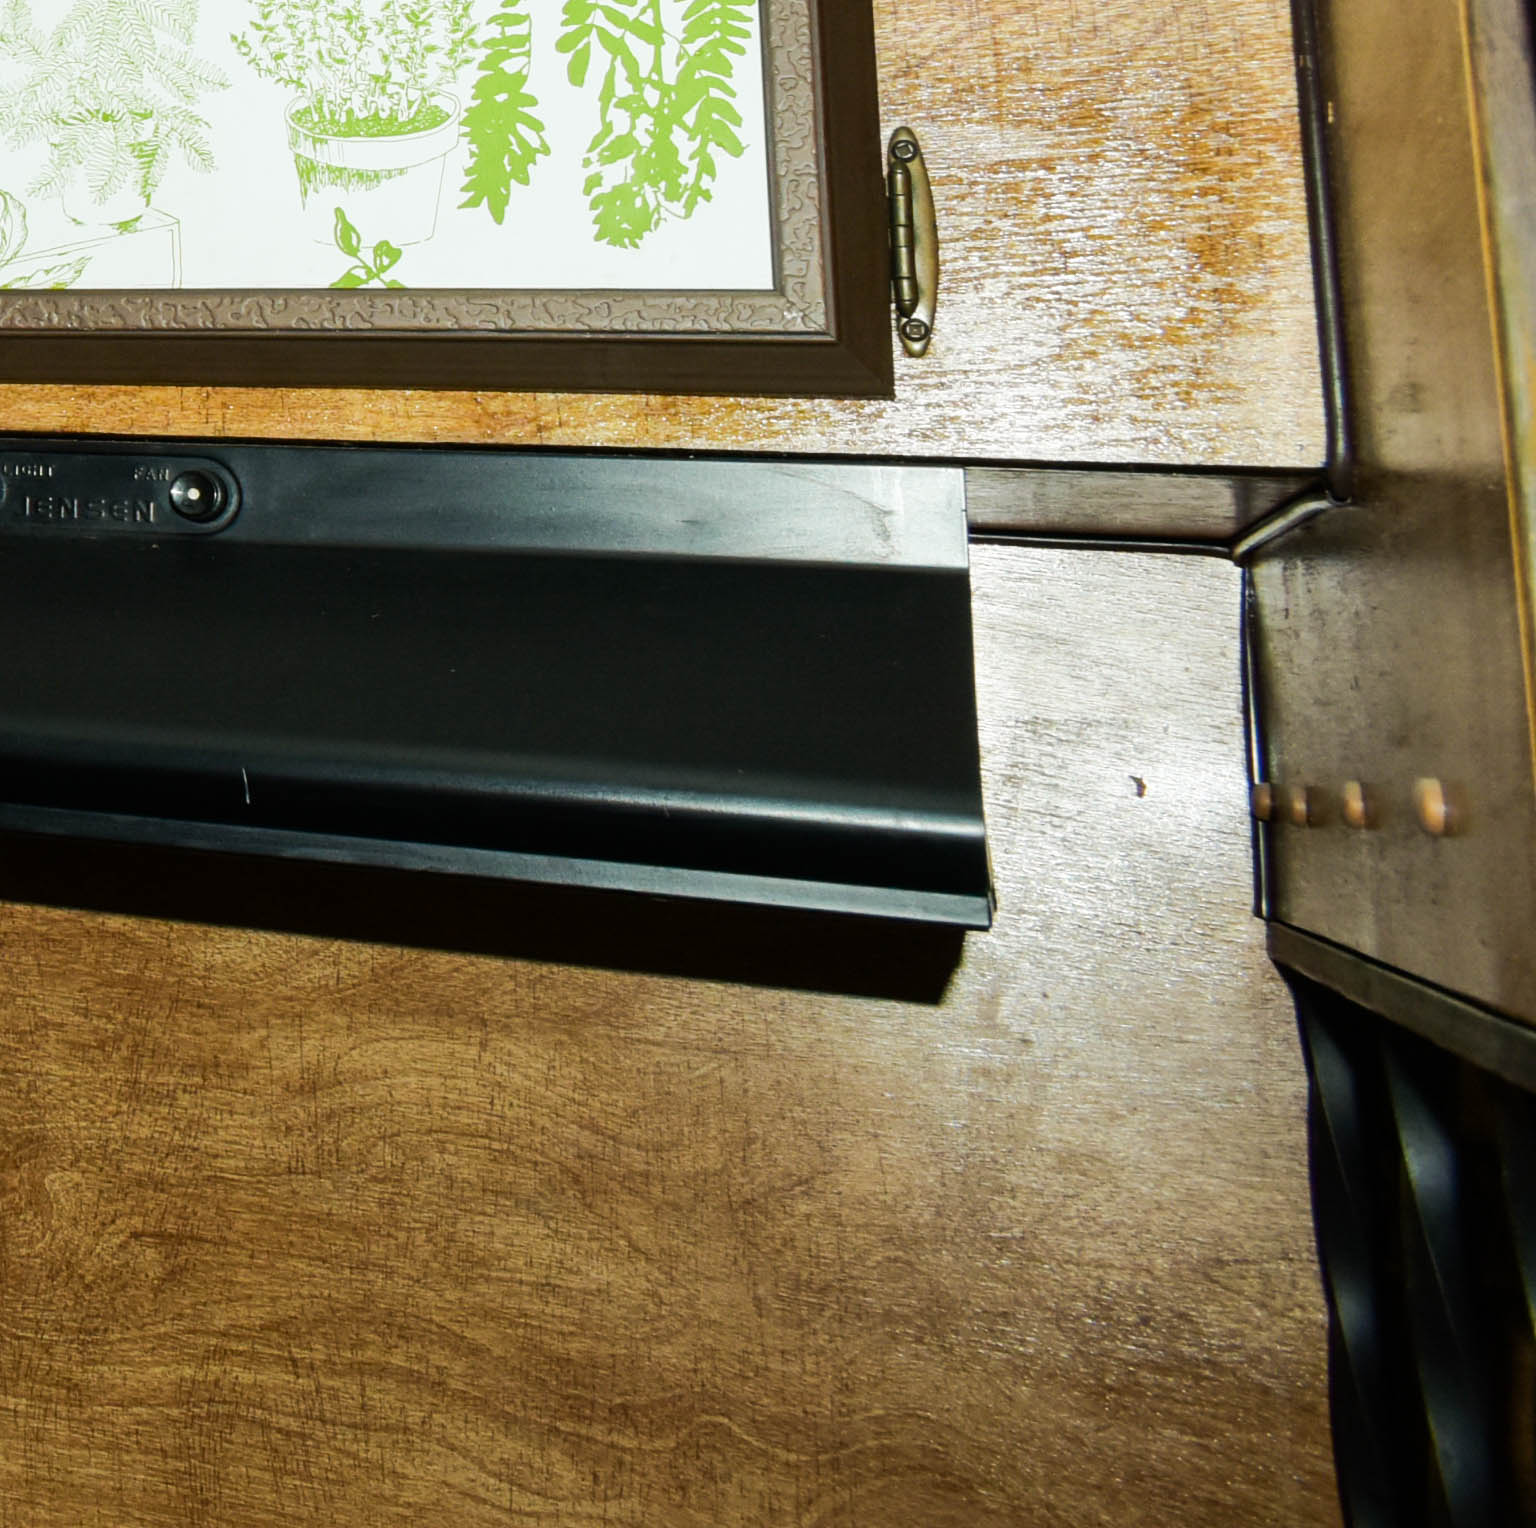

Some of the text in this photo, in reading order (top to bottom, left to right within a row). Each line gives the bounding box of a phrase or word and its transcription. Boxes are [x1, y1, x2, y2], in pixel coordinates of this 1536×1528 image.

[2, 463, 56, 478] LIGHT
[132, 465, 171, 481] FAN
[20, 495, 157, 524] JENSEN
